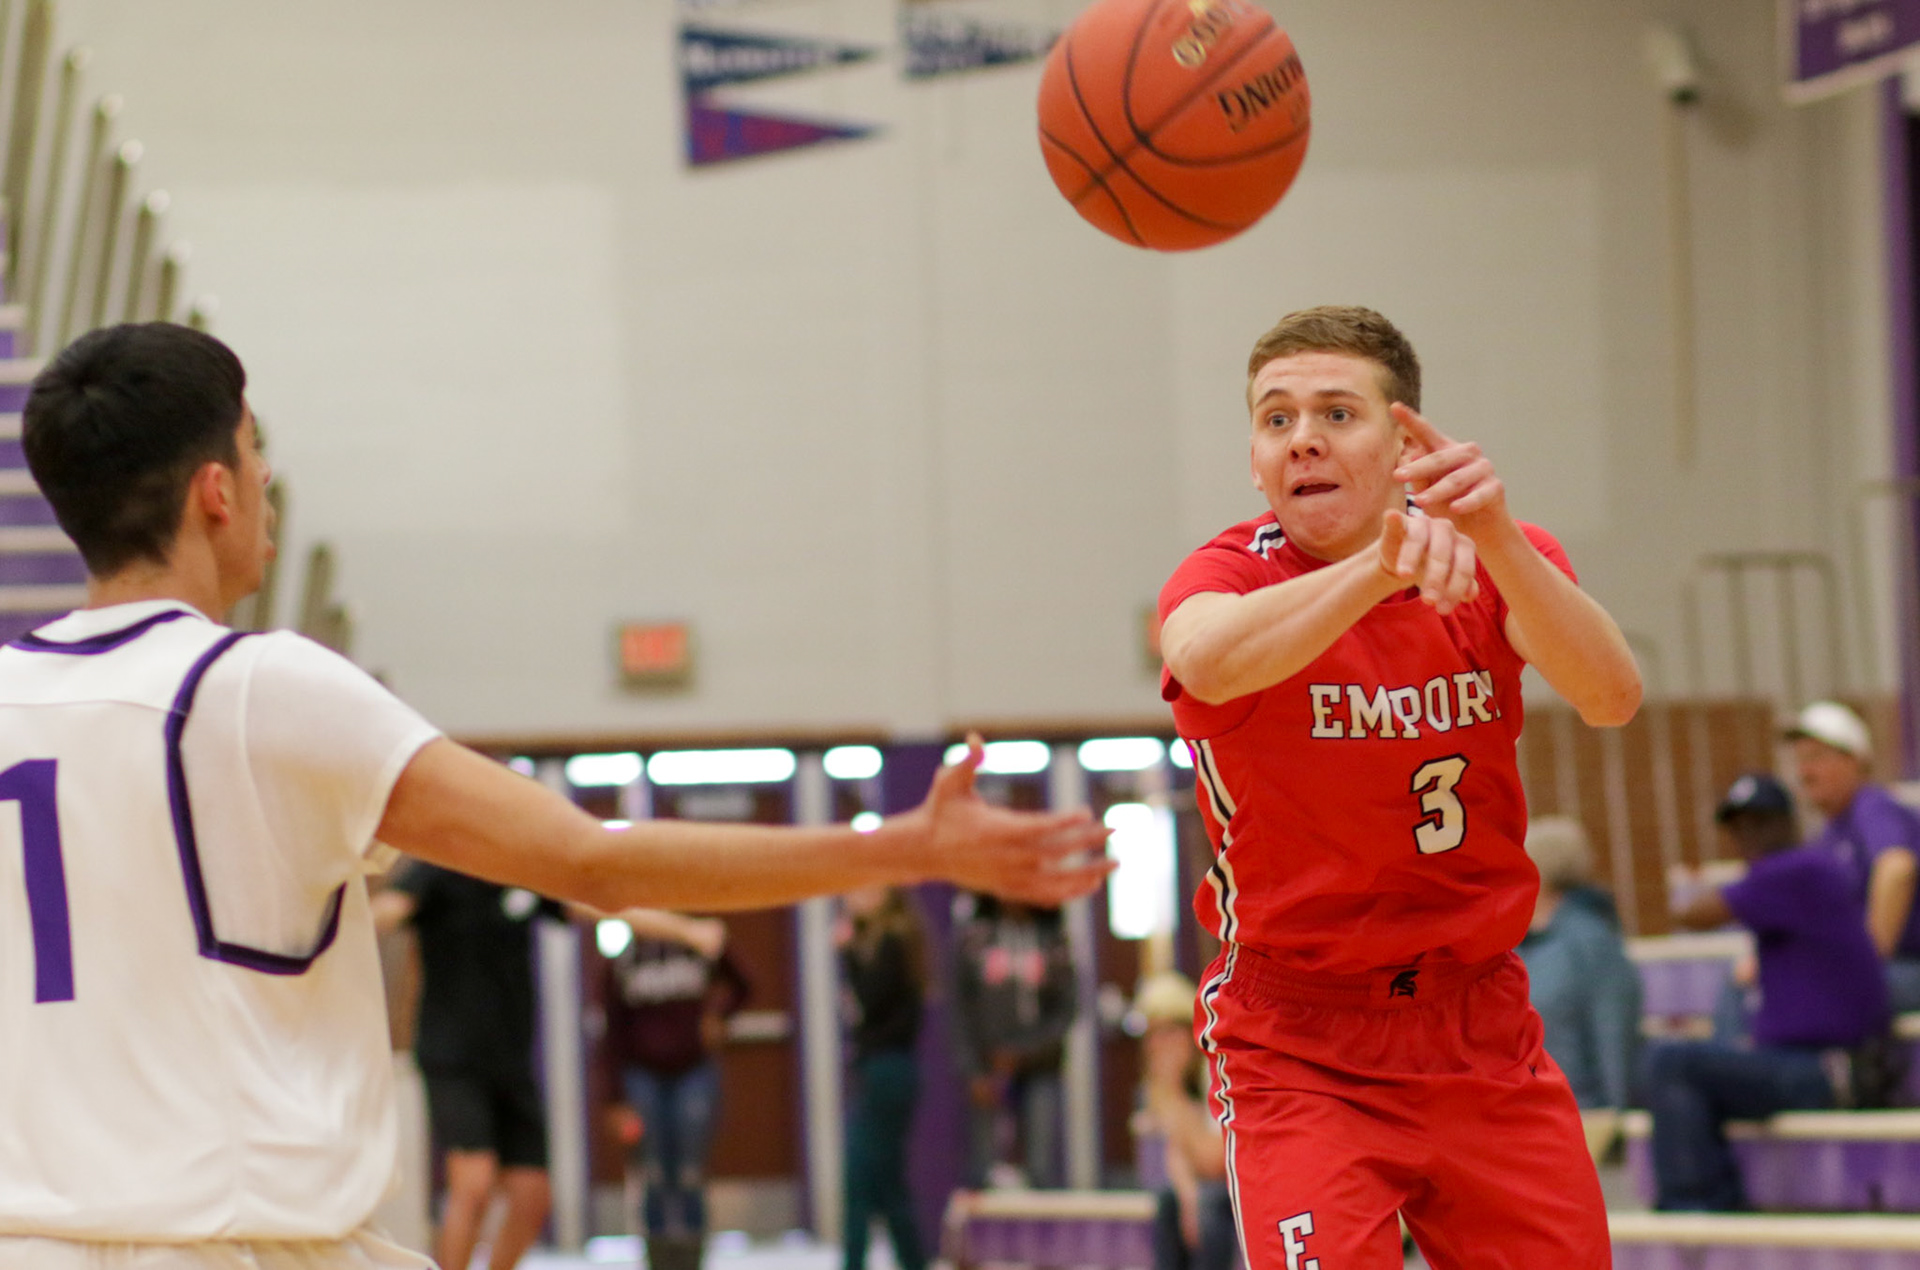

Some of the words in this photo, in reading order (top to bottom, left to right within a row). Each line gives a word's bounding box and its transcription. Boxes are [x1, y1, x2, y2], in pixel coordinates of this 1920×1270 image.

[1308, 669, 1501, 739] EMPOR
[1410, 753, 1470, 854] 3
[0, 758, 75, 1003] 1
[1277, 1211, 1320, 1270] E
